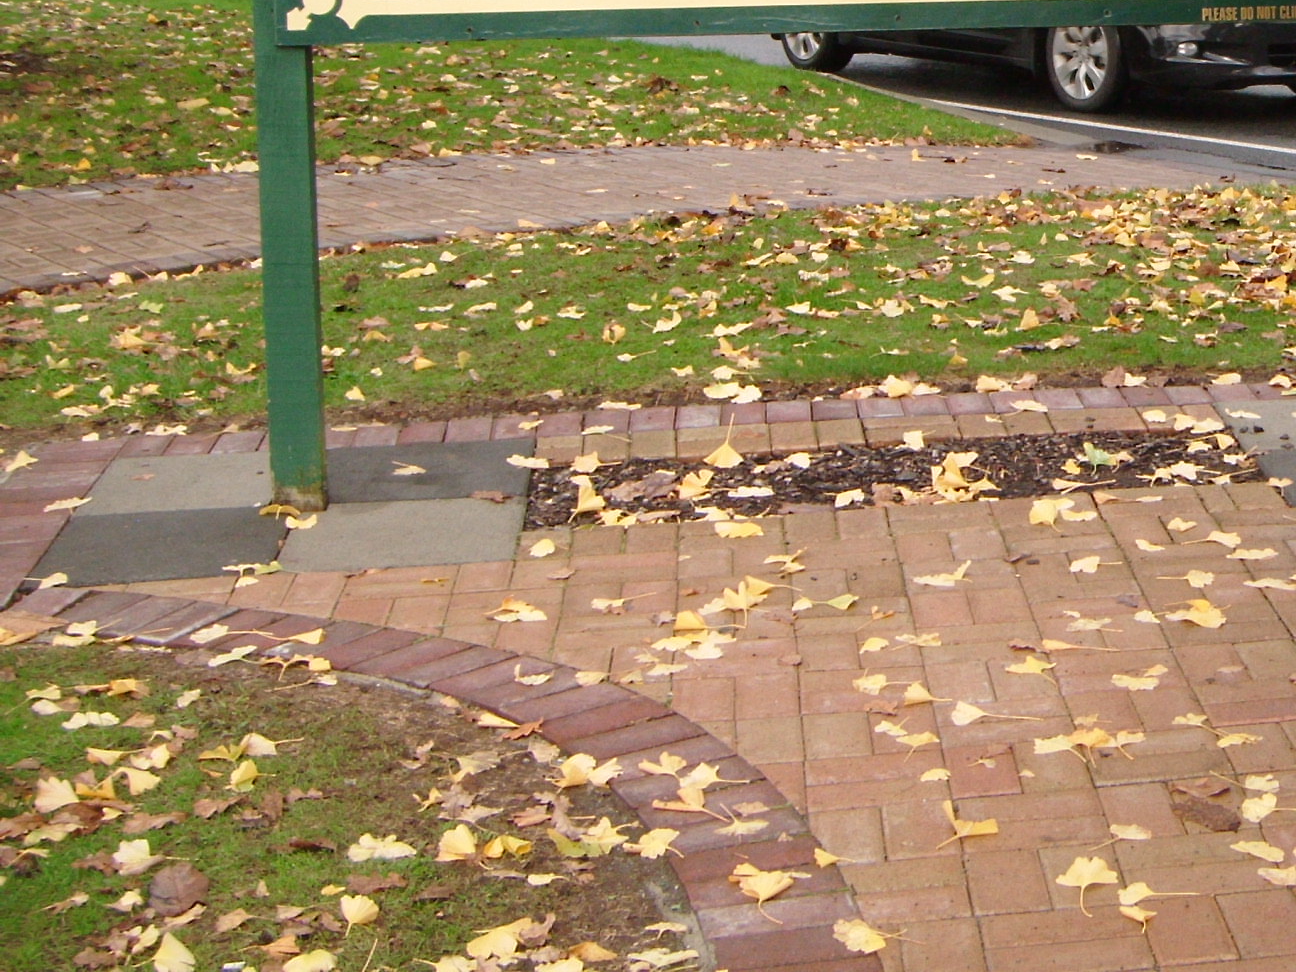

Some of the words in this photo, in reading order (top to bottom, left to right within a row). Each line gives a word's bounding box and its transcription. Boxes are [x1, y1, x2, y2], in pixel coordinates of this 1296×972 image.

[1202, 6, 1238, 21] PLEASE
[1240, 6, 1254, 20] DO
[1256, 5, 1278, 20] NOT
